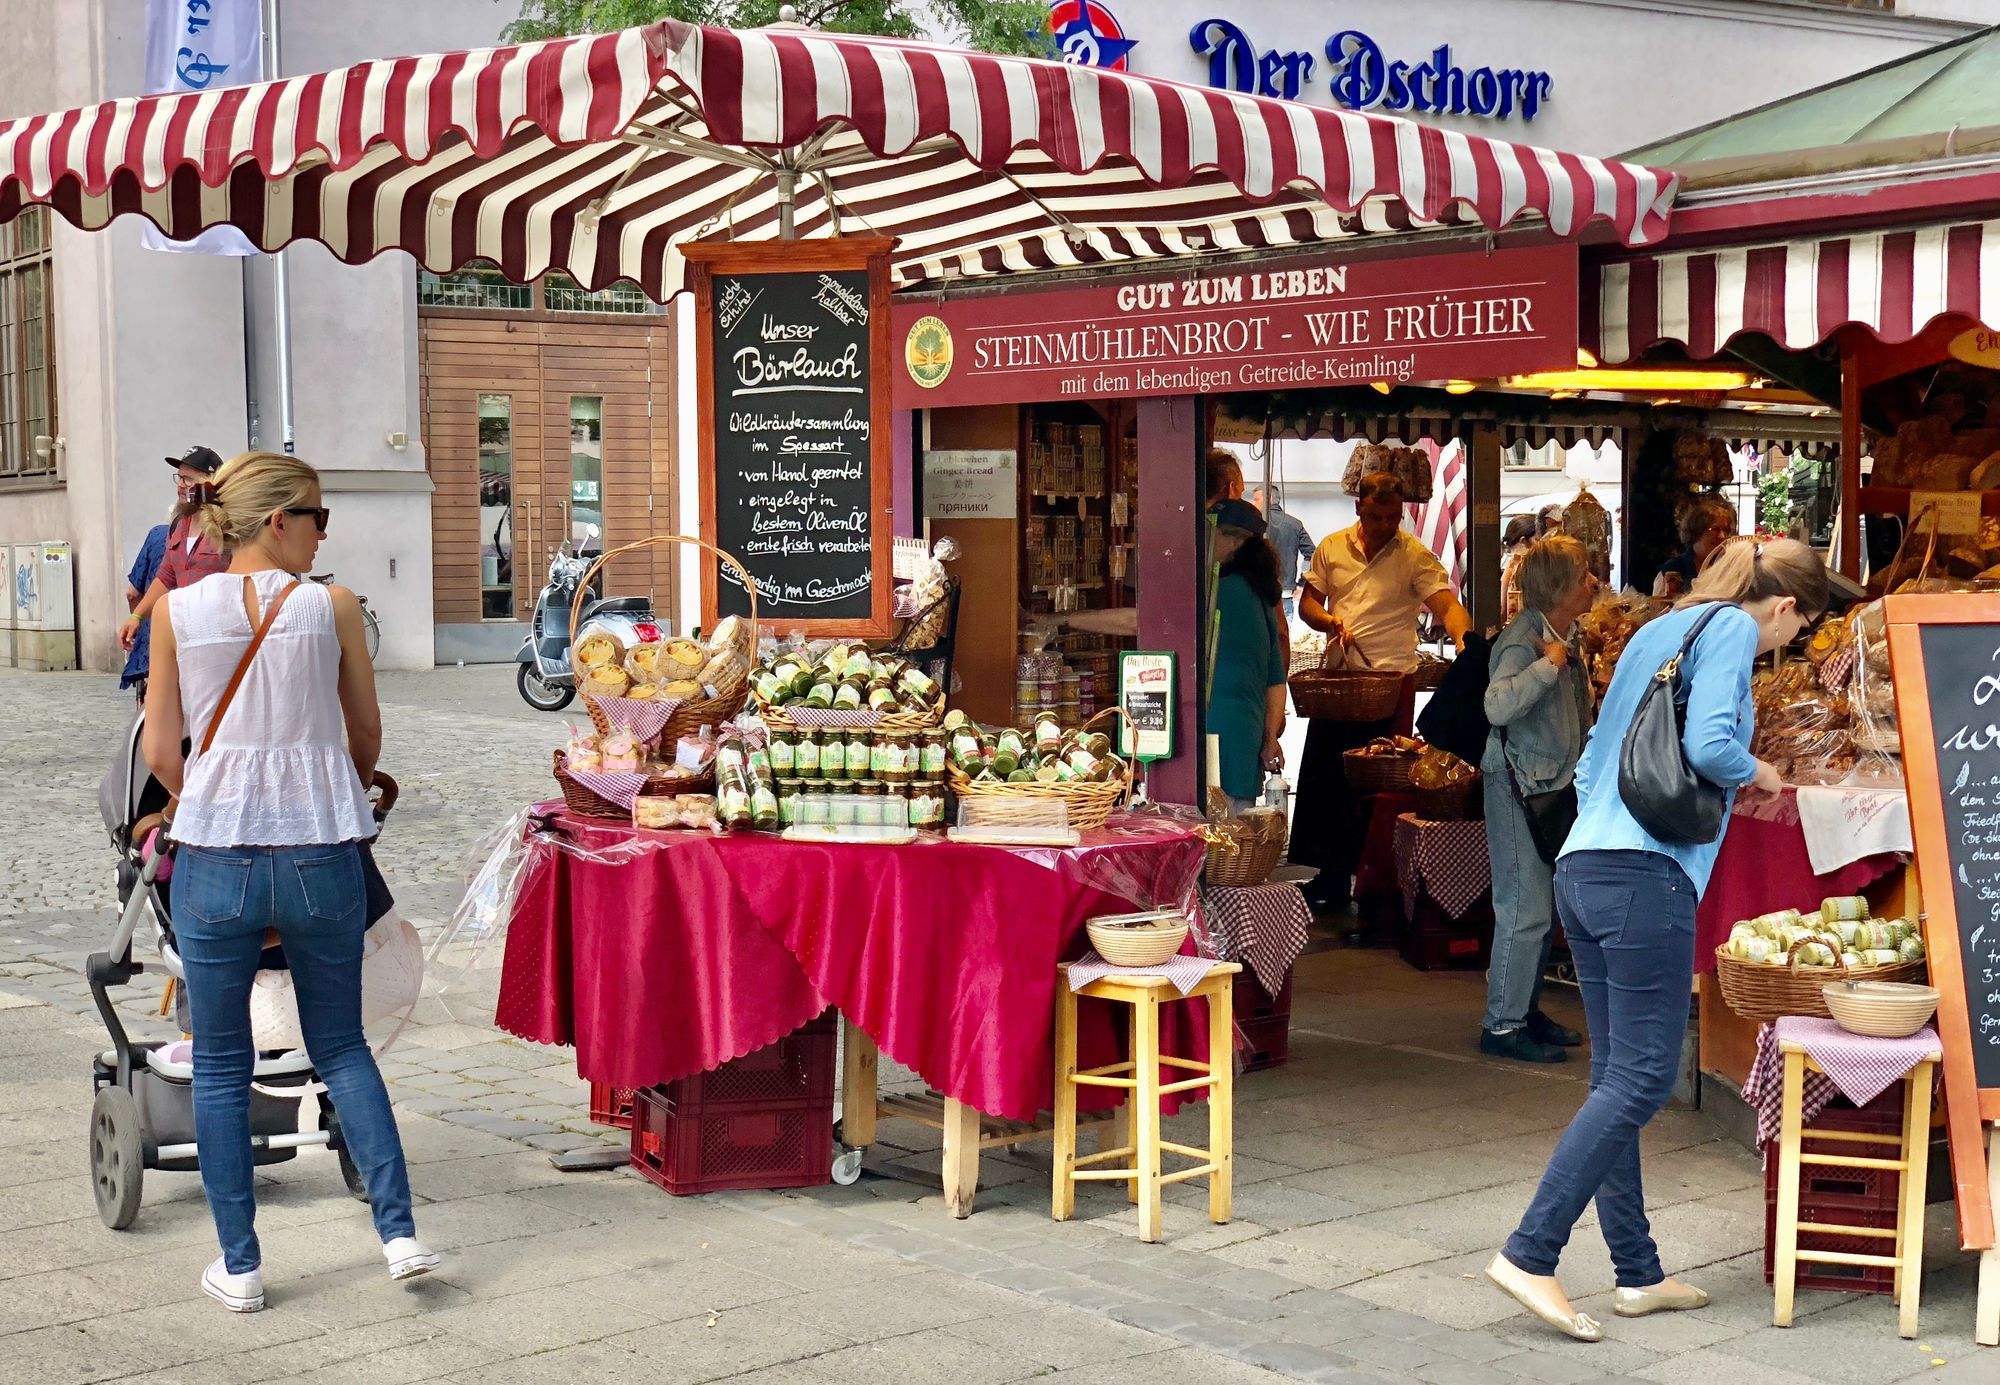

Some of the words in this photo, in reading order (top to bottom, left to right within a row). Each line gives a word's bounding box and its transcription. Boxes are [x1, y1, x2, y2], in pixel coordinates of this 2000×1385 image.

[1189, 17, 1318, 100] Der
[1324, 29, 1553, 121] Pschorr
[719, 278, 741, 310] nicht
[819, 274, 869, 326] monatelang
[1117, 283, 1174, 312] GUT
[1182, 273, 1242, 306] ZUM
[1250, 266, 1348, 301] LEBEN
[720, 290, 751, 328] erhitzt
[812, 287, 854, 324] haltbar
[761, 313, 819, 341] Unser
[974, 316, 1270, 369] STEINMÜHLENBROT
[1305, 309, 1370, 346] WIE
[1384, 295, 1535, 342] FRÜHER
[733, 343, 862, 386] Bärlauch
[1061, 373, 1087, 394] mit
[1093, 368, 1130, 392] dem
[1136, 361, 1232, 393] lebendigen
[1239, 353, 1416, 384] Getreide-Keimling!
[729, 408, 869, 440] Wildkräutersammlung
[752, 438, 769, 452] im
[780, 435, 845, 457] Spessart
[745, 471, 769, 483] von
[772, 460, 808, 482] Hand
[810, 460, 863, 488] geerntet
[933, 467, 964, 477] Ginger
[967, 467, 993, 475] Bread
[750, 490, 816, 514] eingelegt
[820, 494, 838, 507] in
[938, 502, 988, 514] пряники
[752, 512, 803, 533] bestem
[806, 566, 872, 598] Geschmack
[1960, 792, 1985, 807] dem
